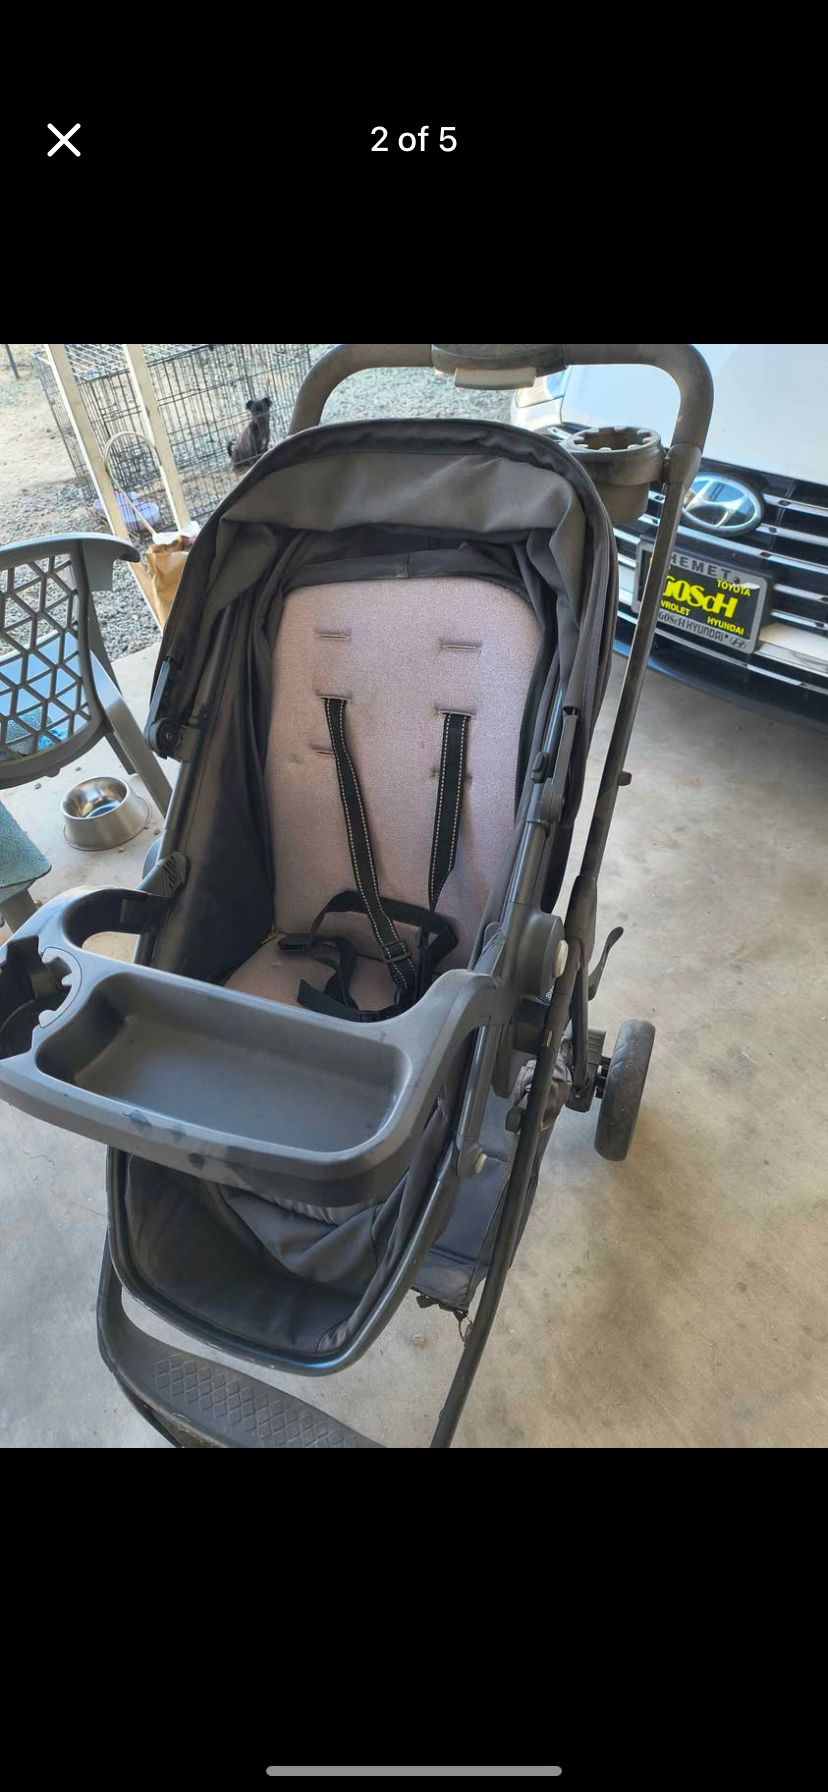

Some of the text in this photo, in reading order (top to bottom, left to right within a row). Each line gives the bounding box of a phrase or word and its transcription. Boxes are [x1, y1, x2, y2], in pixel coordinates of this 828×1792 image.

[716, 579, 751, 597] TOYOTA
[661, 600, 691, 616] VROLET
[686, 620, 724, 642] HYUNDAI
[707, 616, 745, 636] HYUNDAI
